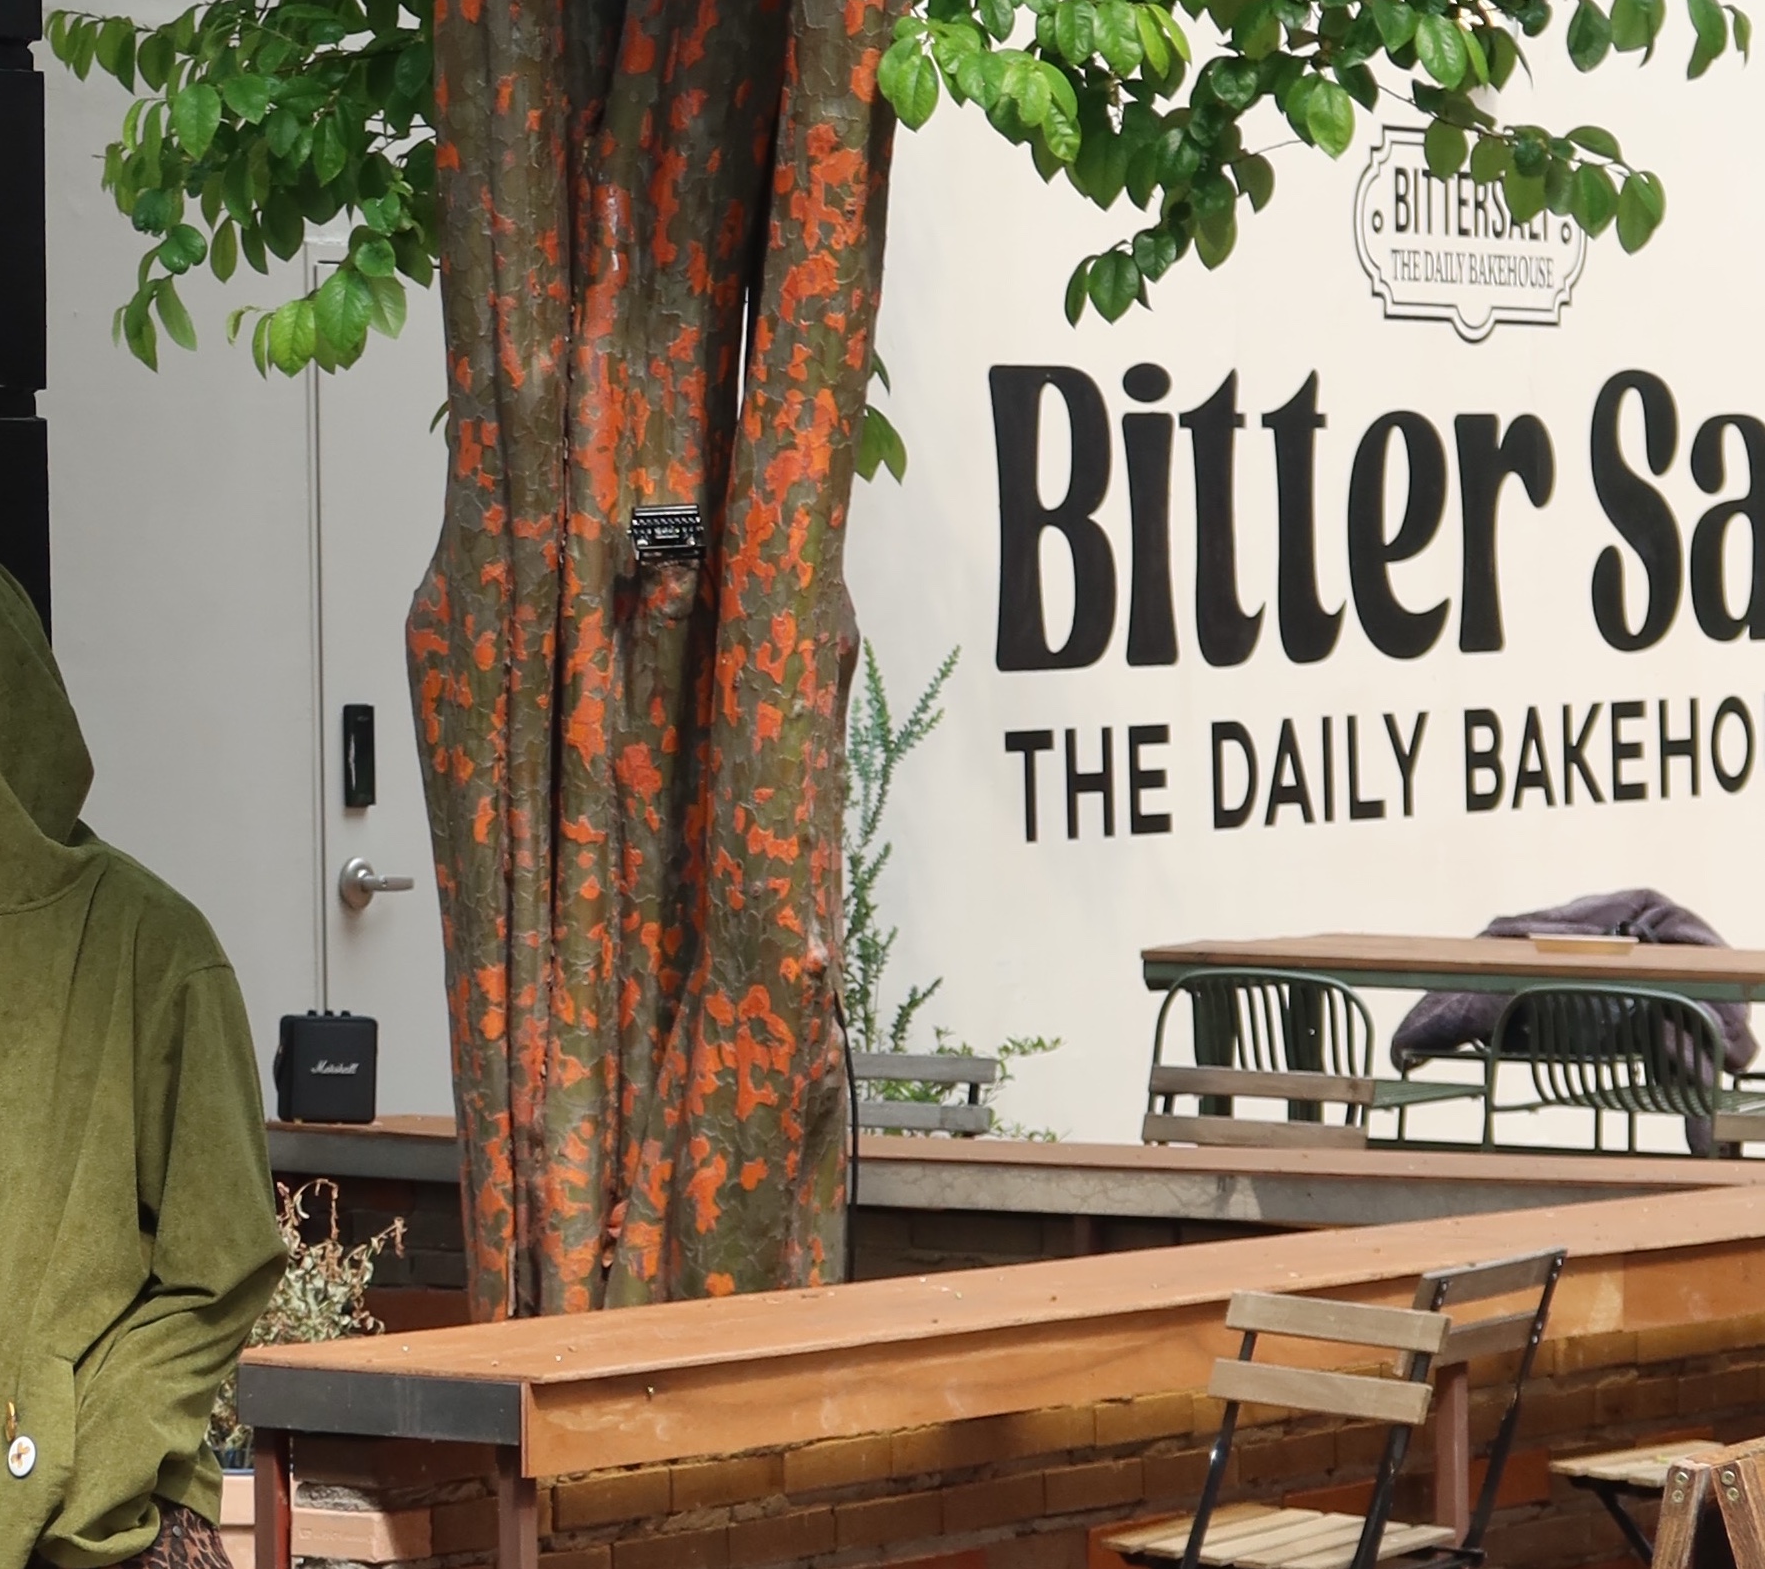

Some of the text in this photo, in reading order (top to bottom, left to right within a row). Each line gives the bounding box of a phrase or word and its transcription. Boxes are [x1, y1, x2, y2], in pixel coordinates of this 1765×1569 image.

[1394, 166, 1549, 241] BITTERS
[1391, 248, 1555, 289] THE DAILY BAKEHOUSE
[988, 362, 1765, 673] Bitter Sa
[1004, 724, 1172, 843] THE
[1211, 711, 1429, 830] DAILY
